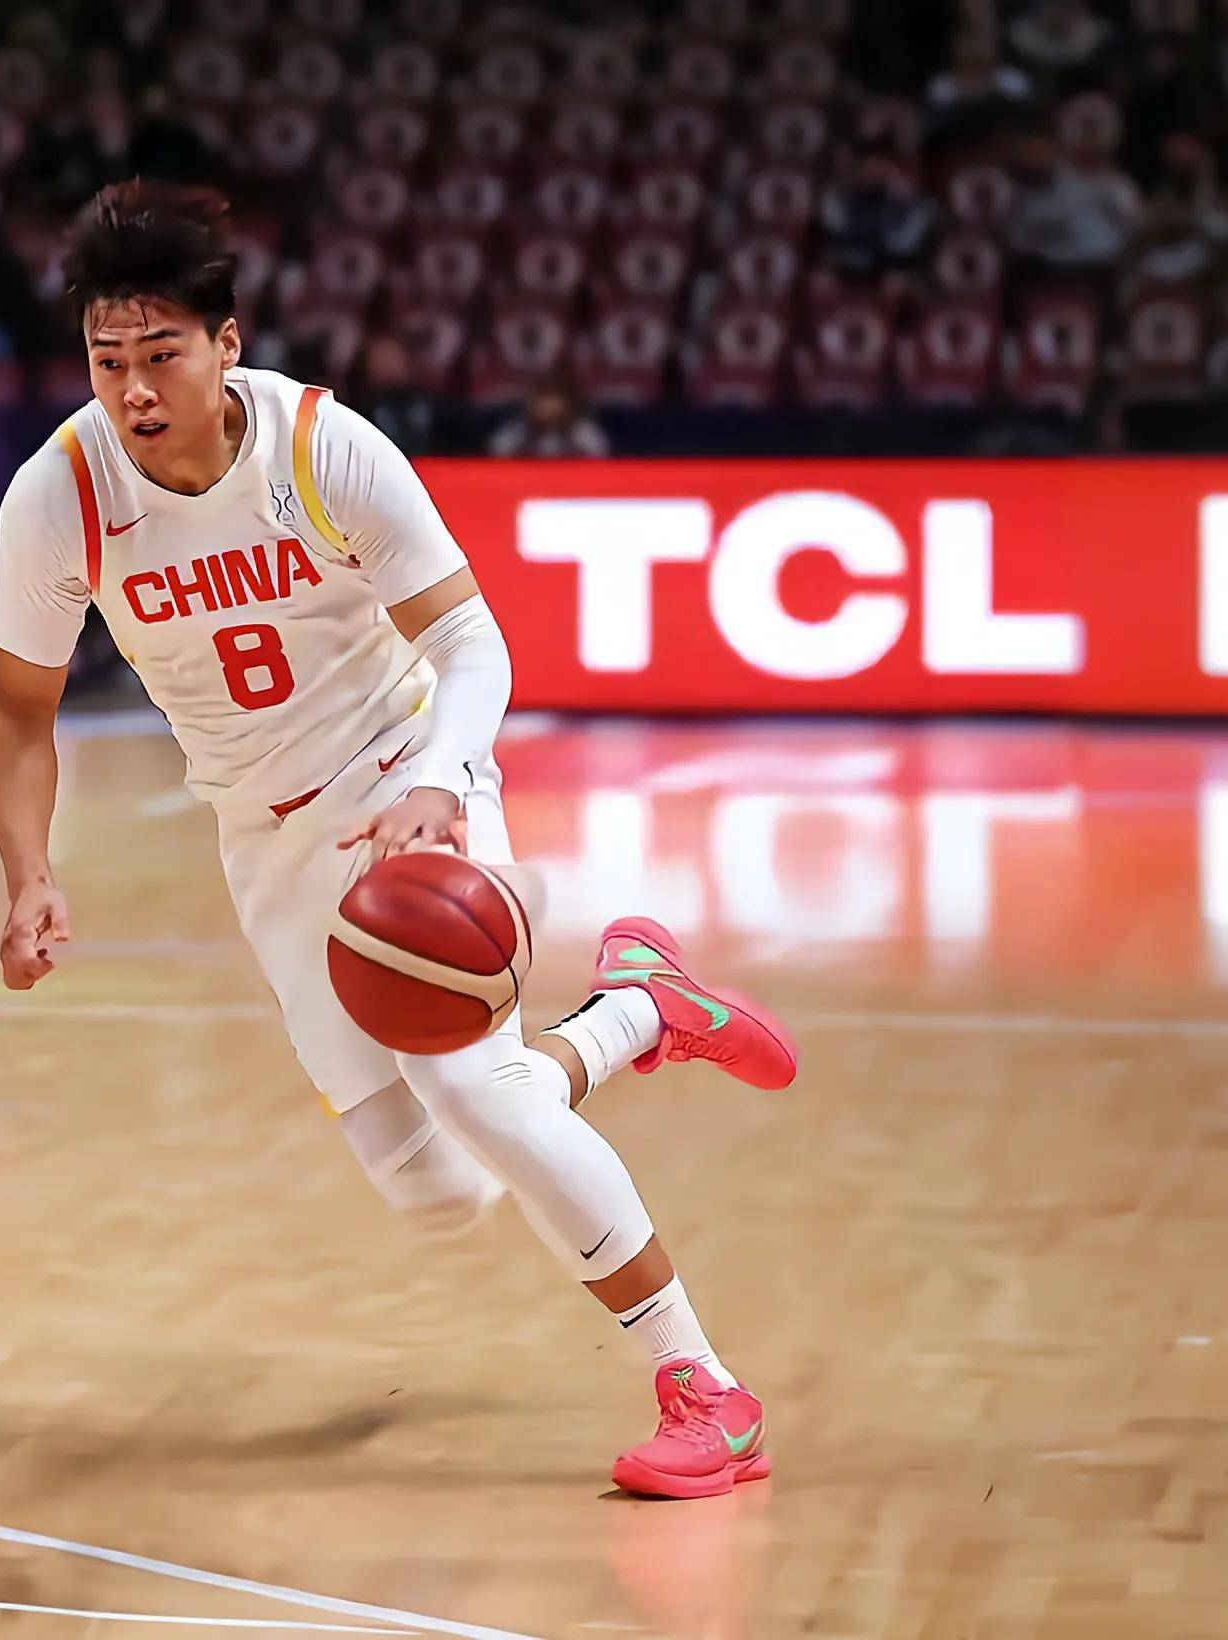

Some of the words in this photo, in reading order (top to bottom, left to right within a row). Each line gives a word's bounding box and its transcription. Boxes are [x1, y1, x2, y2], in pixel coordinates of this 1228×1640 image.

[122, 538, 323, 624] CHINA
[517, 491, 1086, 680] TCL
[212, 624, 295, 710] 8
